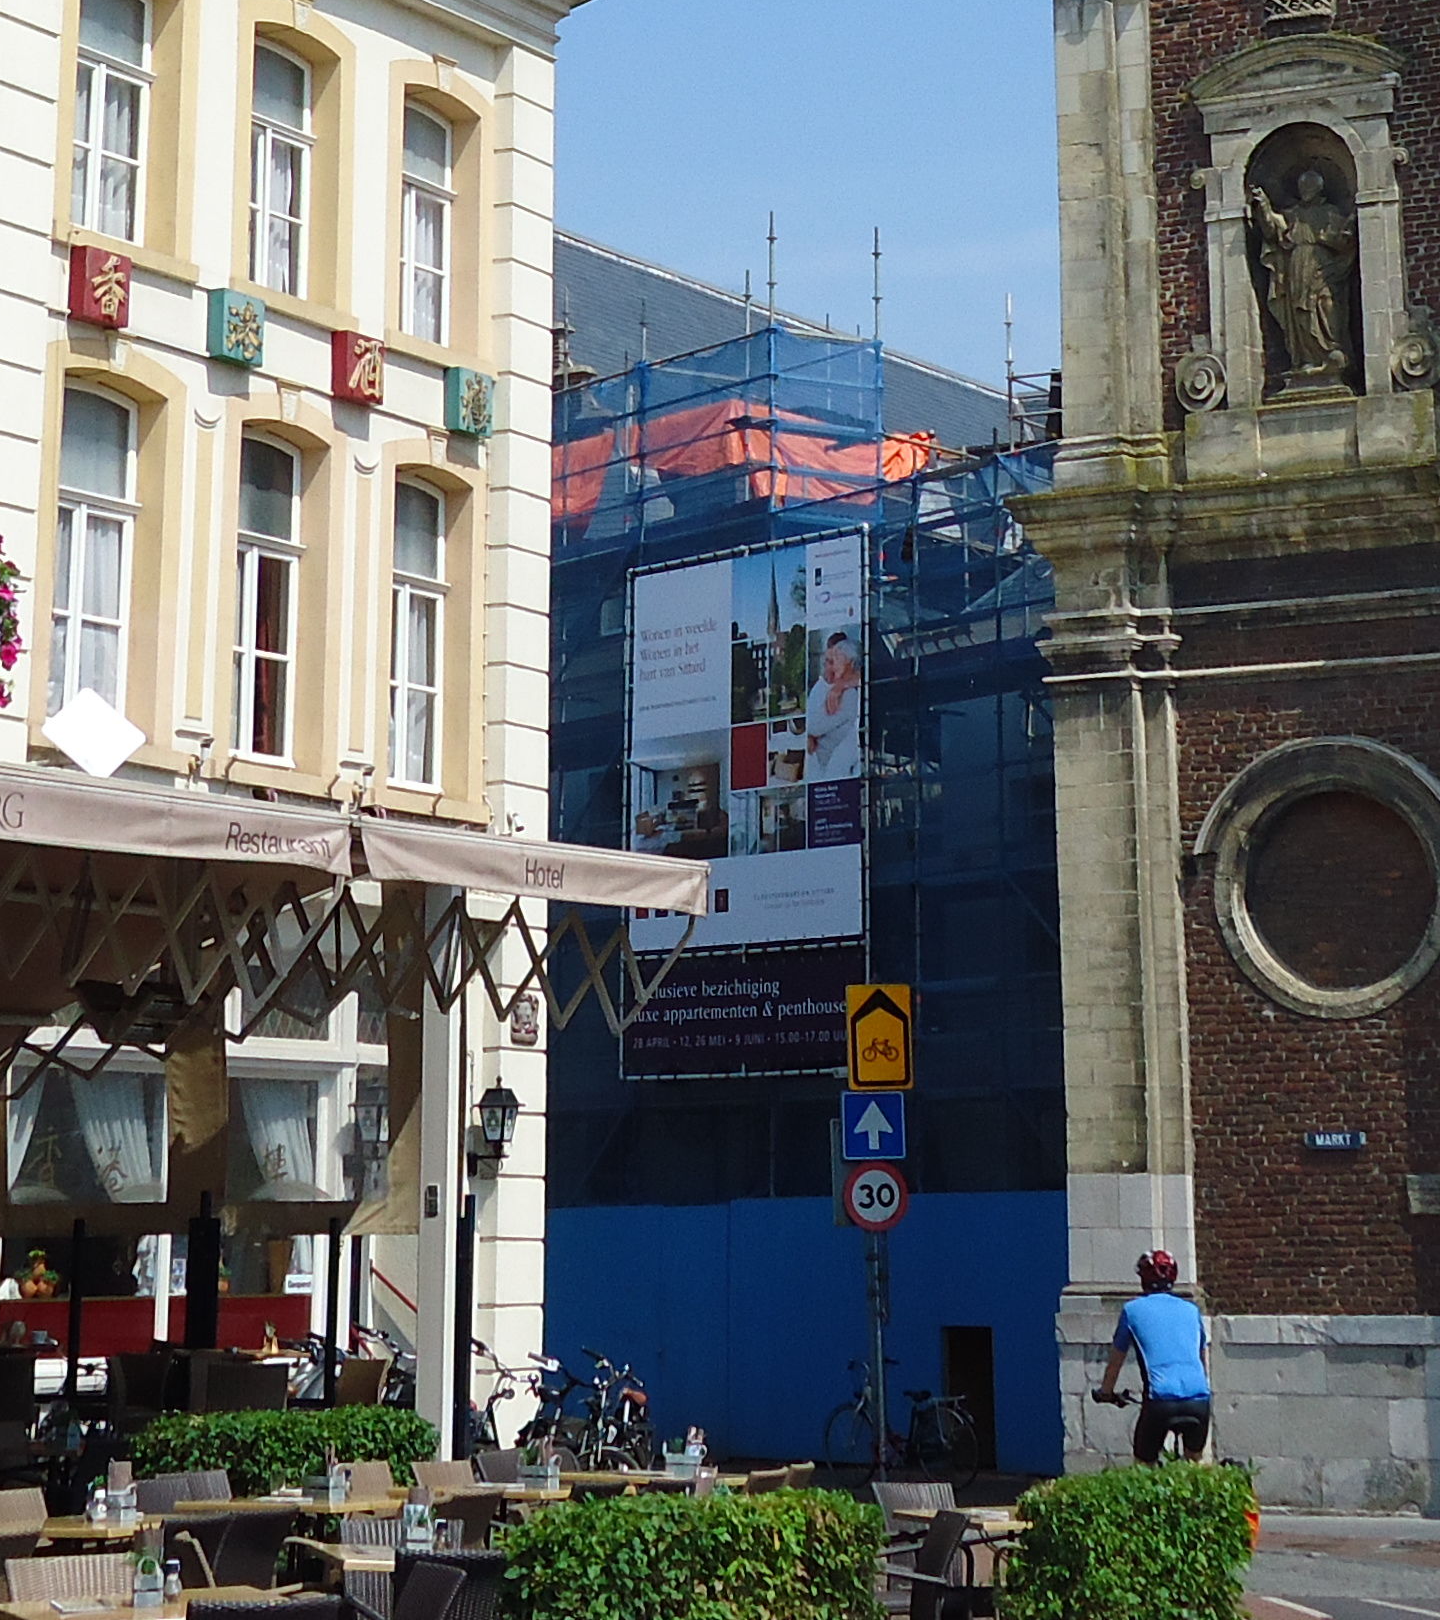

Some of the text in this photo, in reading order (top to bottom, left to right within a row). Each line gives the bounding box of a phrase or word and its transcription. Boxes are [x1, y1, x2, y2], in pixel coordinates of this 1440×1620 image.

[225, 821, 332, 859] Restaurant
[525, 858, 565, 890] Hotel
[652, 978, 780, 1000] lusieve bezichtiging
[633, 1009, 659, 1023] uxe
[663, 1005, 757, 1026] appartementen
[763, 1000, 774, 1017] &
[646, 1036, 670, 1048] APRIL
[1315, 1133, 1351, 1146] MARKT
[858, 1183, 895, 1209] 30
